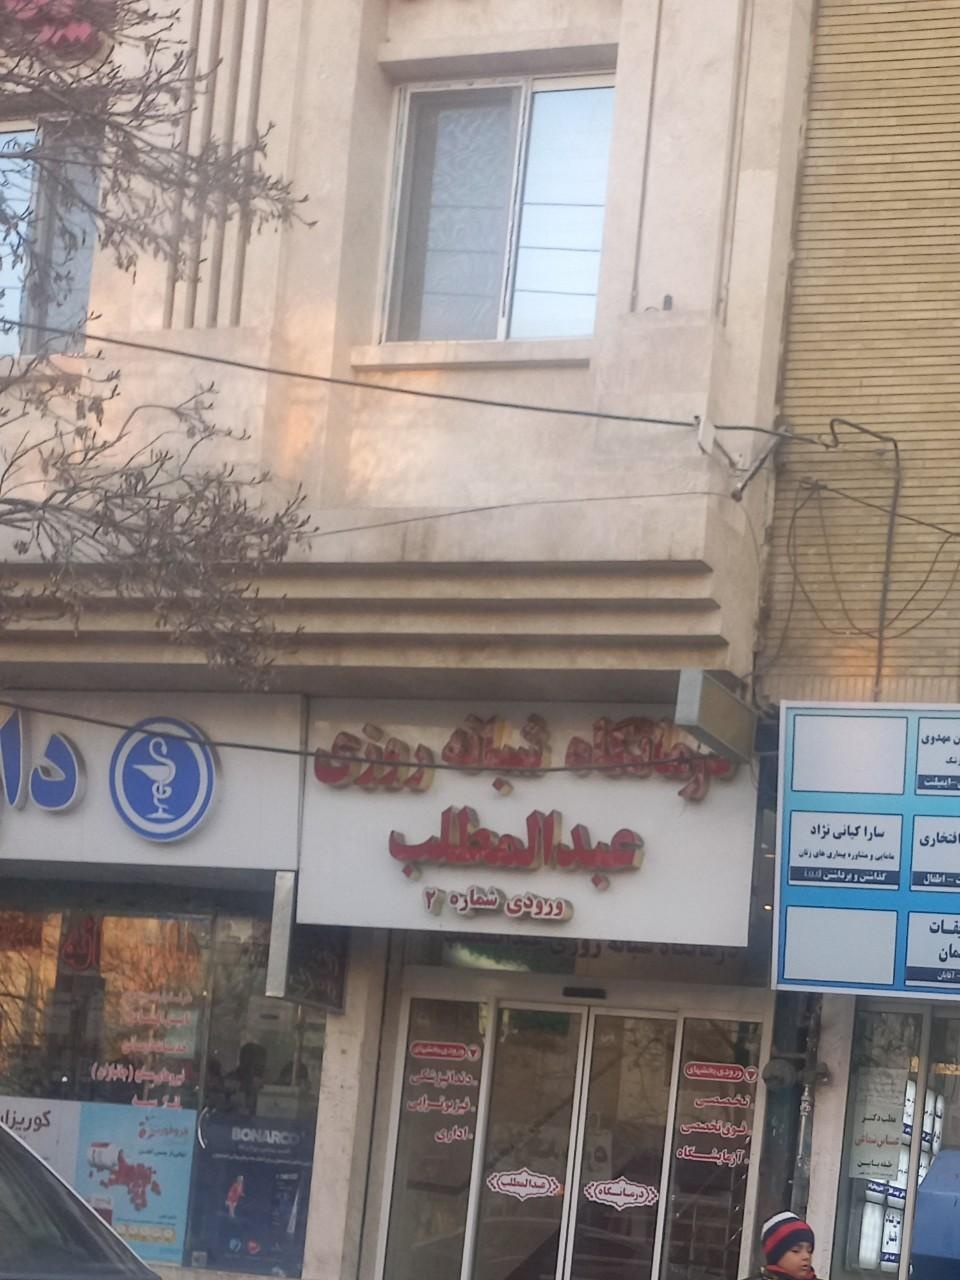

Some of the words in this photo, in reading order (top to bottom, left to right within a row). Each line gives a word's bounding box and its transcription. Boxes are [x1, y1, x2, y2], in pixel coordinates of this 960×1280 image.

[921, 733, 951, 745] مهدوی
[313, 722, 435, 792] روزی
[442, 712, 551, 796] شبانه
[810, 823, 830, 840] نژاد
[832, 824, 861, 840] کیانی
[864, 825, 885, 841] سارا
[388, 804, 645, 891] عبدالمطلب
[923, 872, 945, 885] اطفال
[424, 888, 437, 908] ۲
[449, 887, 498, 913] شماره
[505, 896, 569, 919] ورودی
[693, 1093, 751, 1109] تخصصی
[434, 1125, 469, 1143] اداری
[676, 1144, 745, 1168] آزمایشگاه
[500, 1177, 546, 1189] عبدالمطلب
[598, 1184, 645, 1201] درمانگاه
